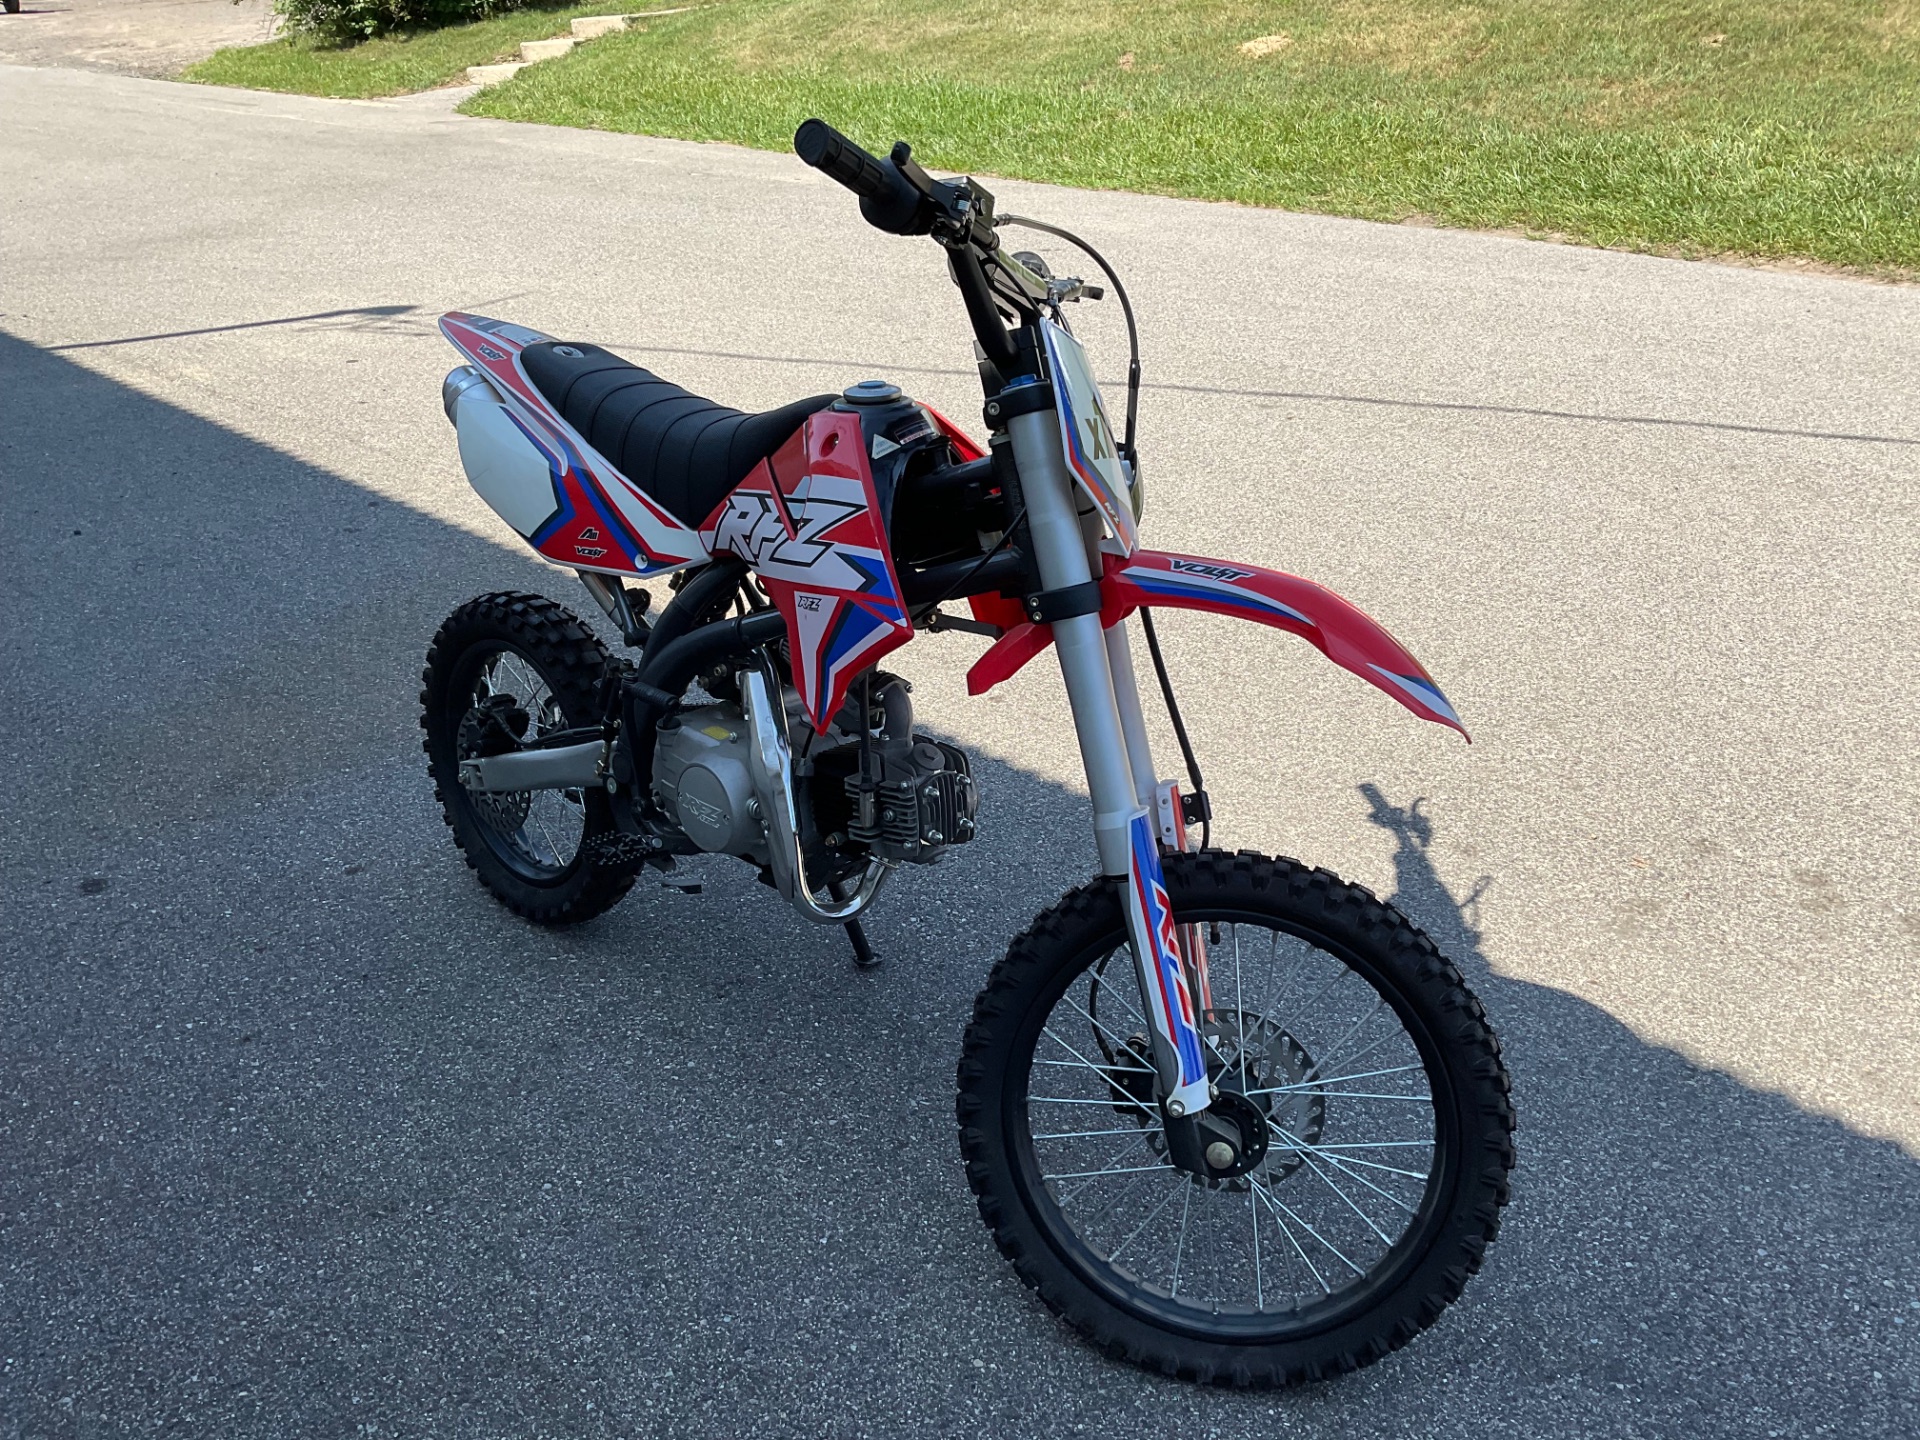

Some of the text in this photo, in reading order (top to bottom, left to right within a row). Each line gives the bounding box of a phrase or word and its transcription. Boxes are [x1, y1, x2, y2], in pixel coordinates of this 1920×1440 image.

[712, 490, 869, 567] RFZ
[1169, 558, 1252, 581] VOLT
[798, 595, 822, 611] RFZ
